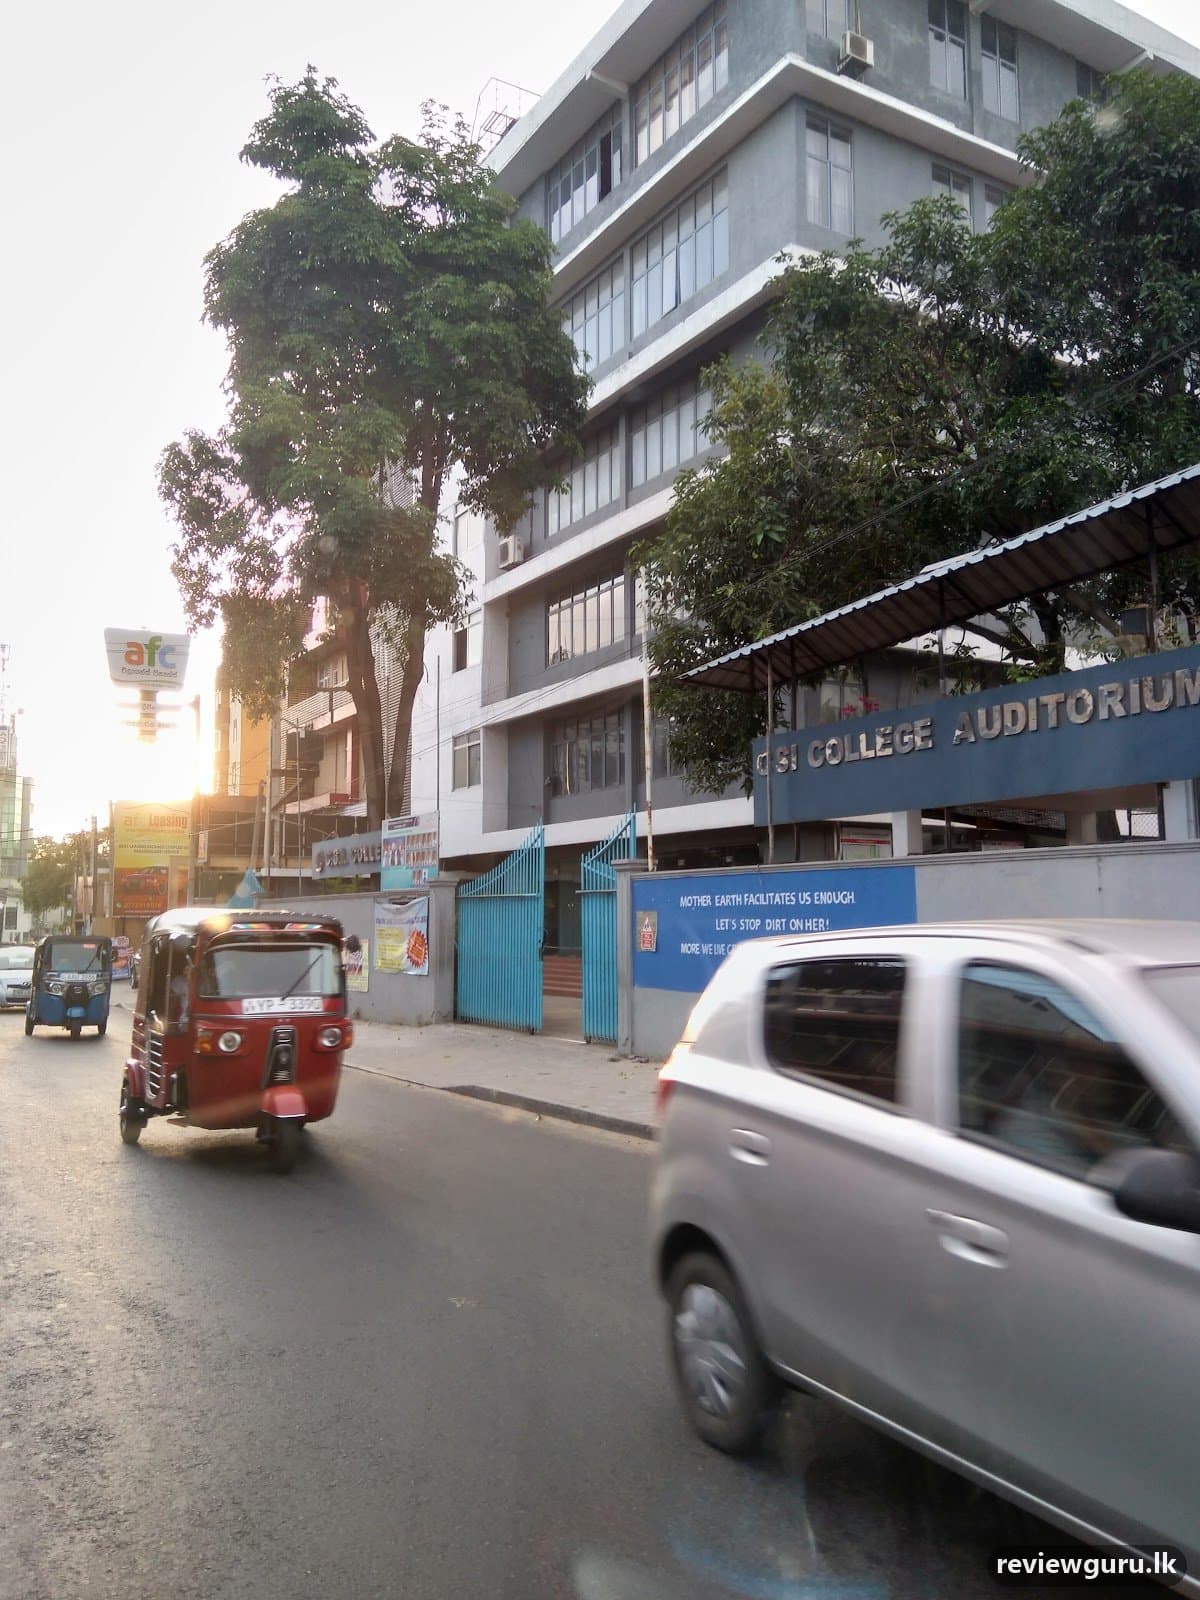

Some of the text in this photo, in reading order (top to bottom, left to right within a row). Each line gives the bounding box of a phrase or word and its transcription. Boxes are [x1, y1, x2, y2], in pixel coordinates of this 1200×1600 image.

[124, 636, 177, 669] afc
[807, 717, 934, 769] COLLEGE
[952, 668, 1200, 745] AUDITORIUM
[680, 891, 855, 907] MOTHER EARTH FACILITATES US ENOUGH
[715, 917, 829, 931] LET'S STOP DIRT ON HER!
[680, 943, 700, 955] MORE
[701, 943, 713, 955] WE
[713, 943, 726, 956] LIVE
